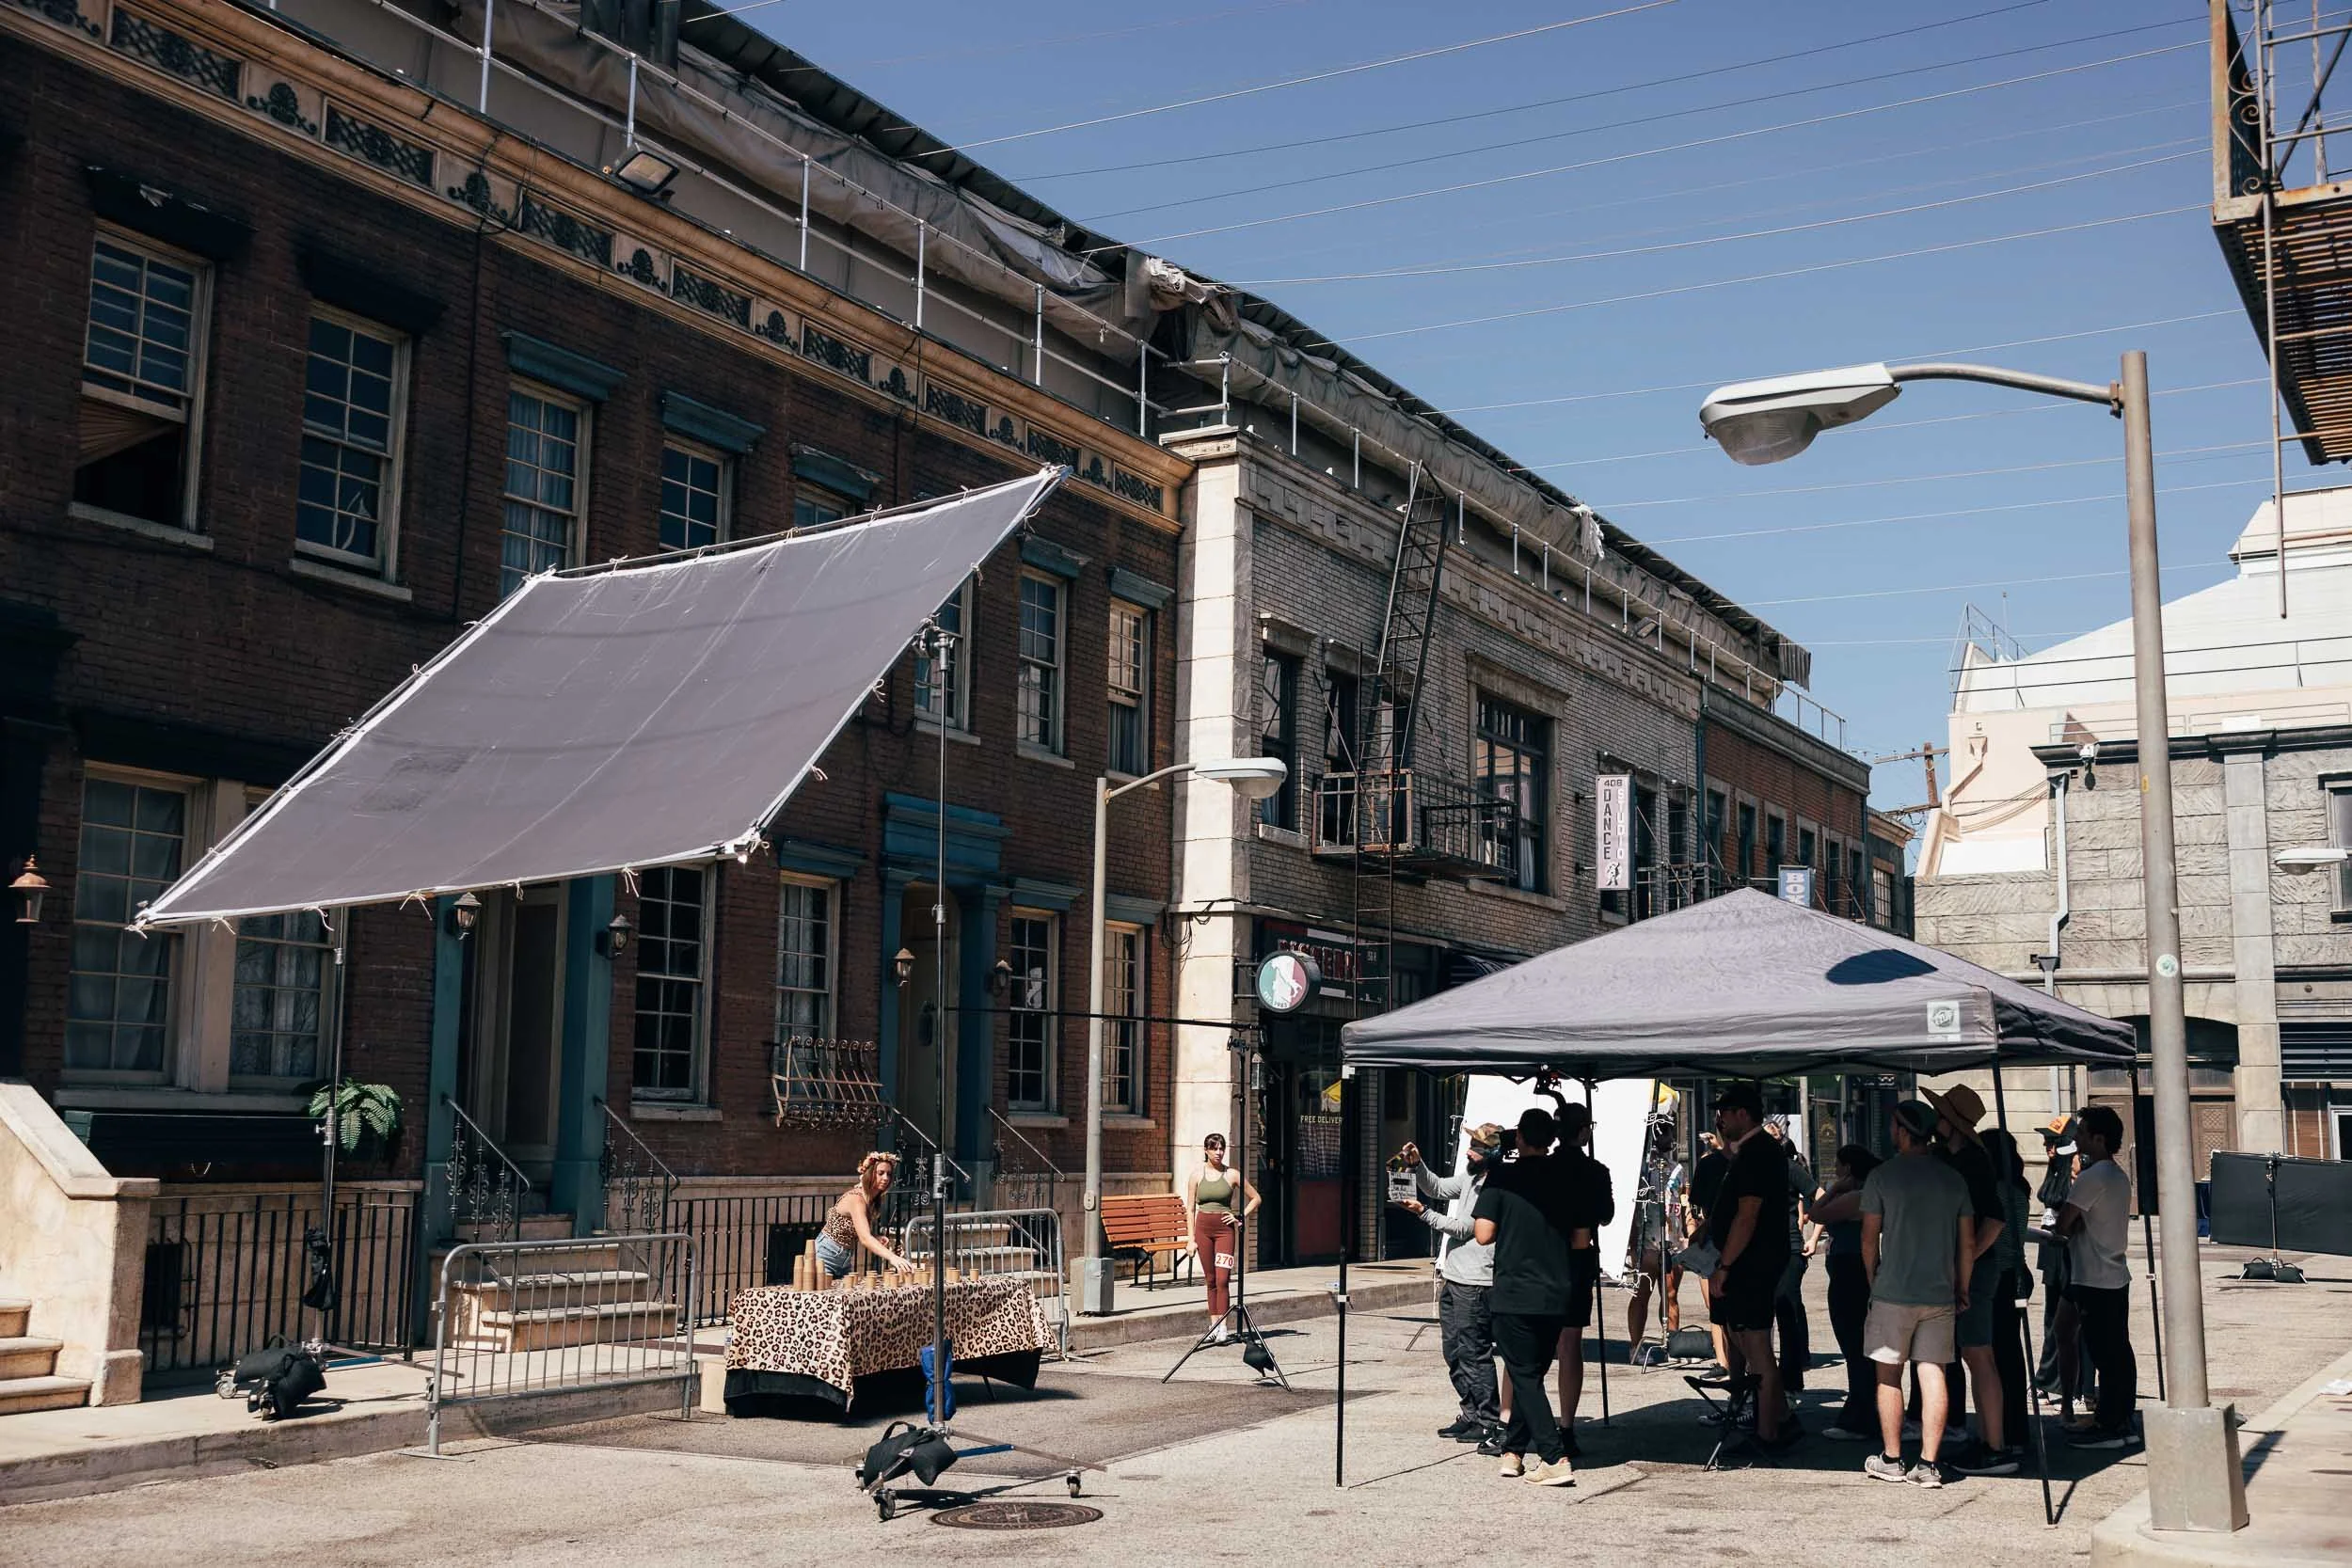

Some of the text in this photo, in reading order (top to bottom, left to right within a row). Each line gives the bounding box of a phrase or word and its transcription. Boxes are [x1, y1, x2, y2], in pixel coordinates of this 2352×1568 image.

[1604, 779, 1622, 787] 408
[1603, 788, 1612, 860] DANCE
[1616, 789, 1625, 860] STUDIO
[1300, 1115, 1315, 1124] FREE
[1216, 1255, 1232, 1267] 270
